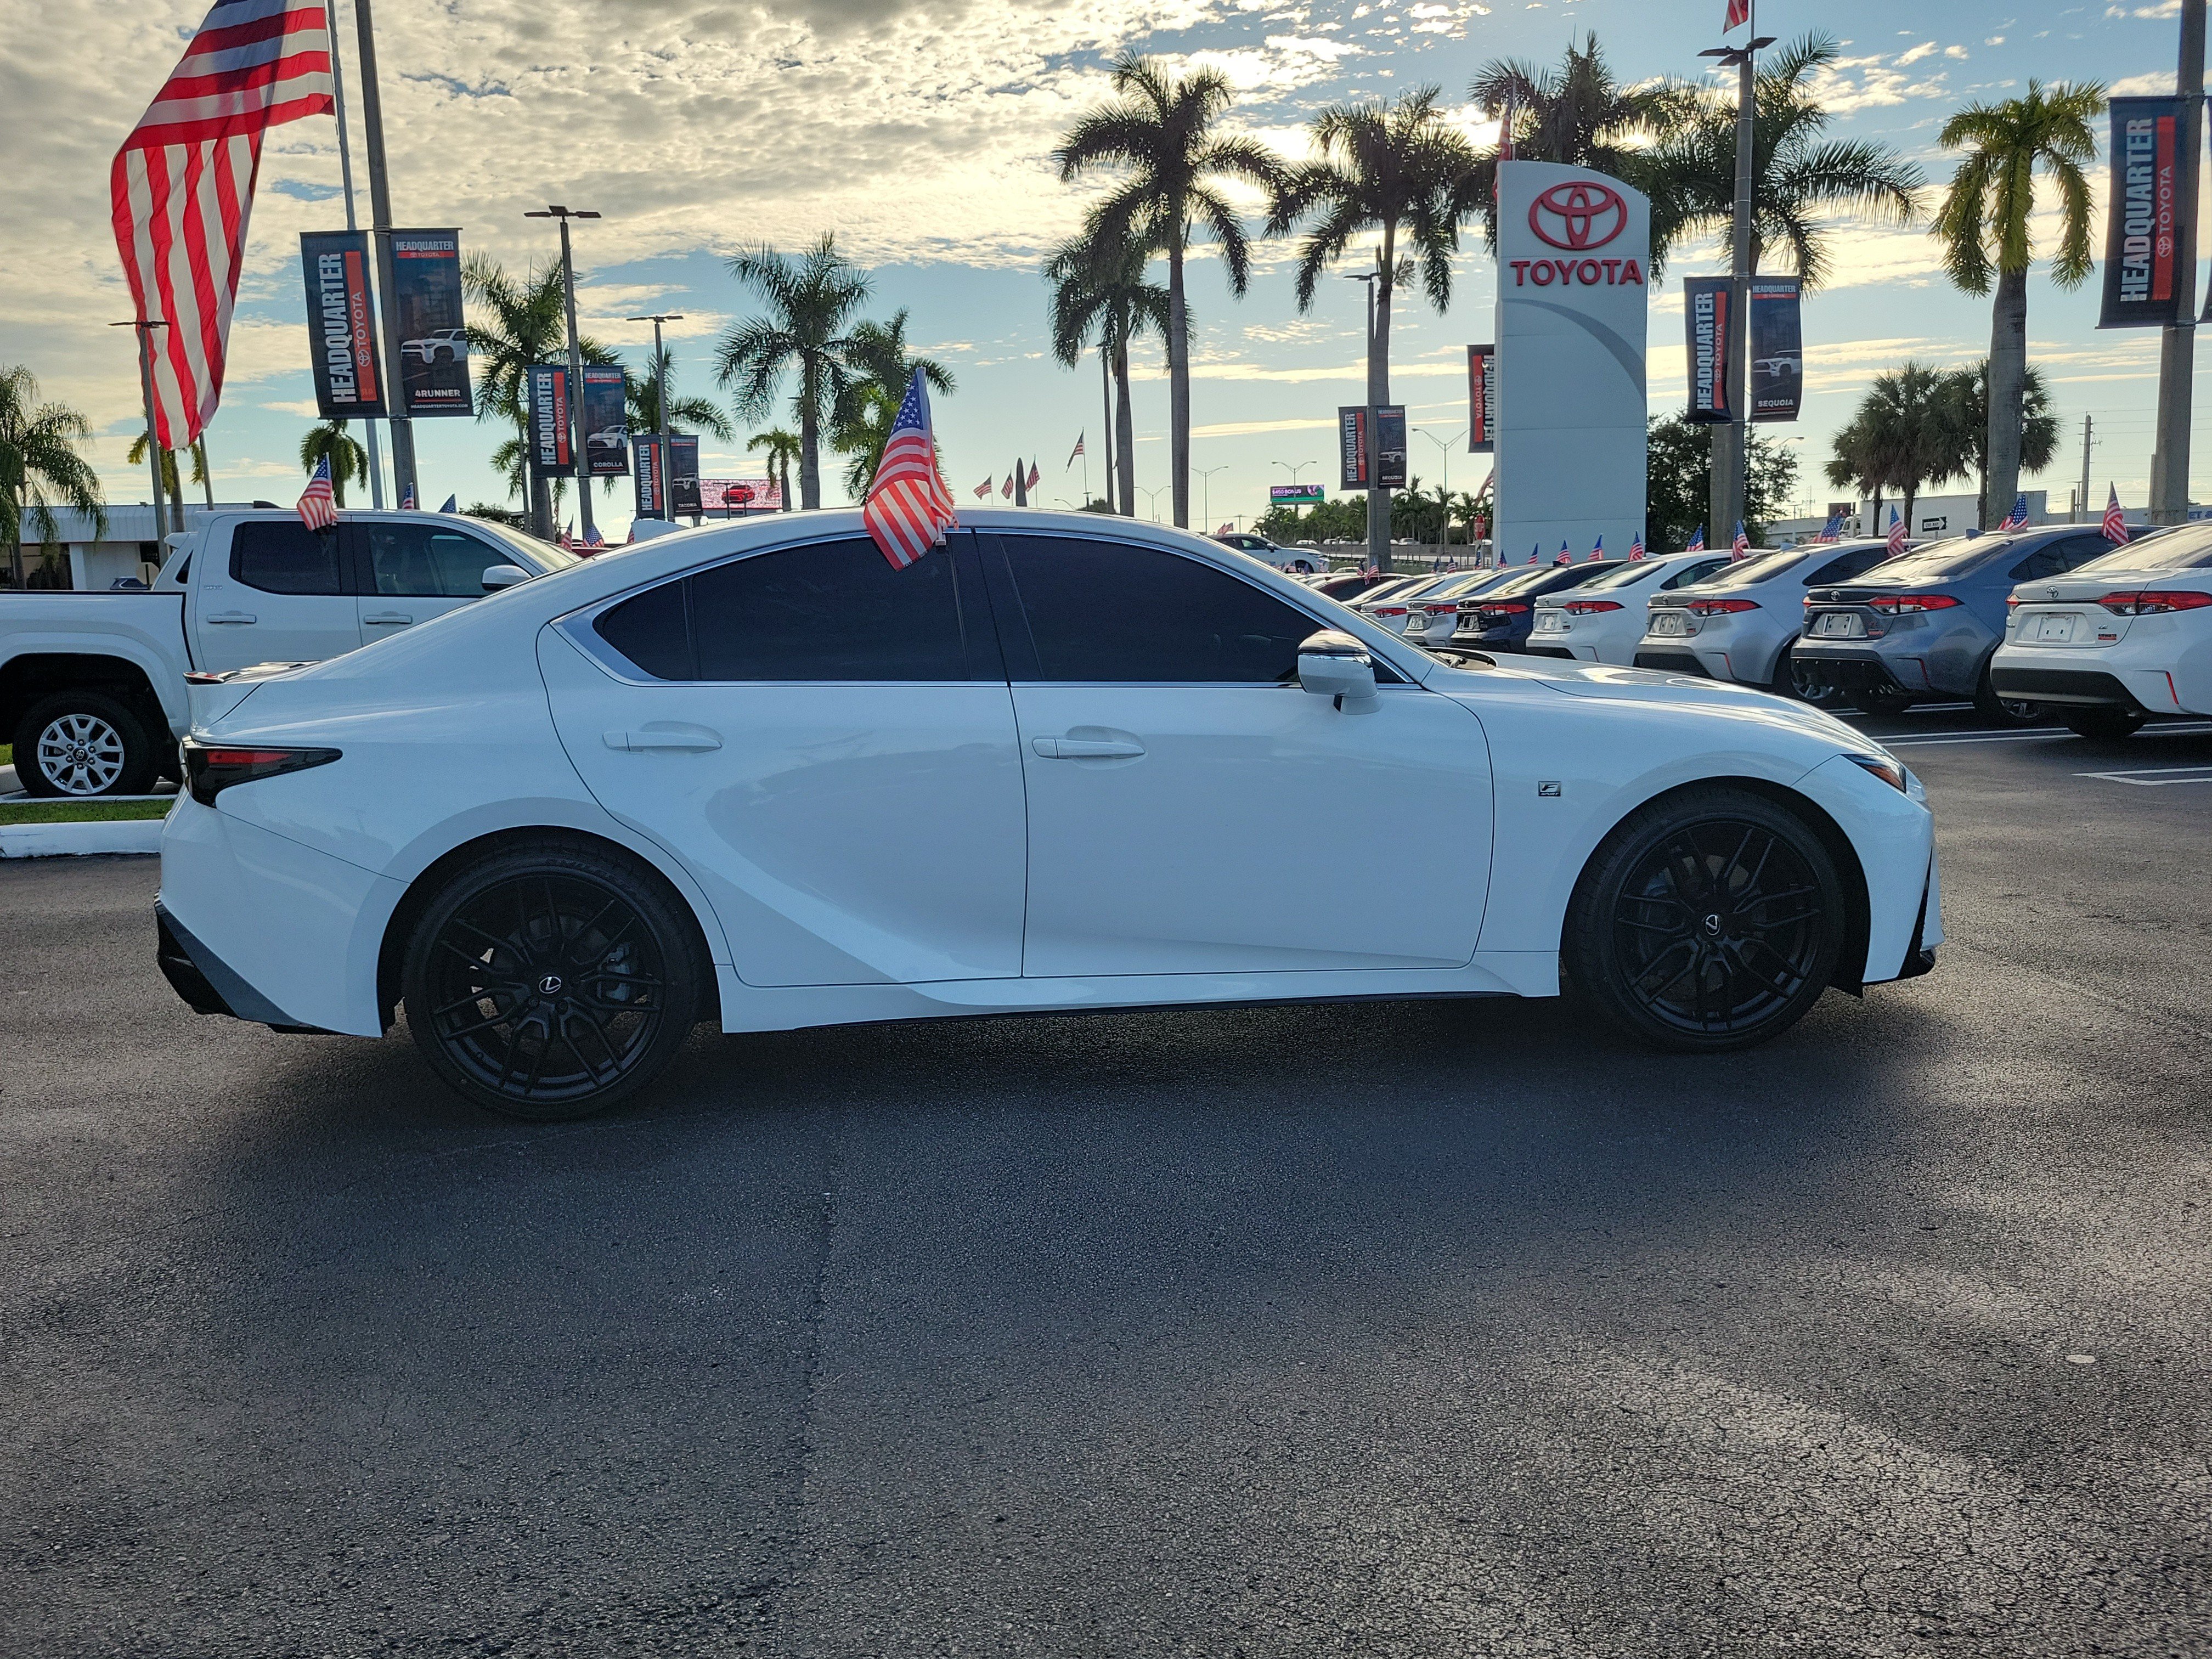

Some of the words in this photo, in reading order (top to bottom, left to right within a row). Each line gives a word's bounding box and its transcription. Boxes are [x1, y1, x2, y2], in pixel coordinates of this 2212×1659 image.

[2120, 118, 2155, 302] HEADQUARTER
[2159, 166, 2171, 234] TOYOTA
[396, 241, 454, 252] HEADQUARTER
[1510, 259, 1643, 286] TOYOTA
[352, 291, 368, 348] TOYOTA
[1753, 285, 1796, 294] HEADQUARTER
[319, 253, 357, 403] HEADQUARTER
[1695, 292, 1714, 409] HEADQUARTER
[415, 389, 461, 397] 4RUNNER
[537, 373, 557, 465] HEADQUARTER
[557, 397, 565, 431] TOYOTA
[1758, 399, 1793, 407] SEQUOIA
[639, 444, 653, 511] HEADQUARTER
[1345, 413, 1357, 482] HEADQUARTER
